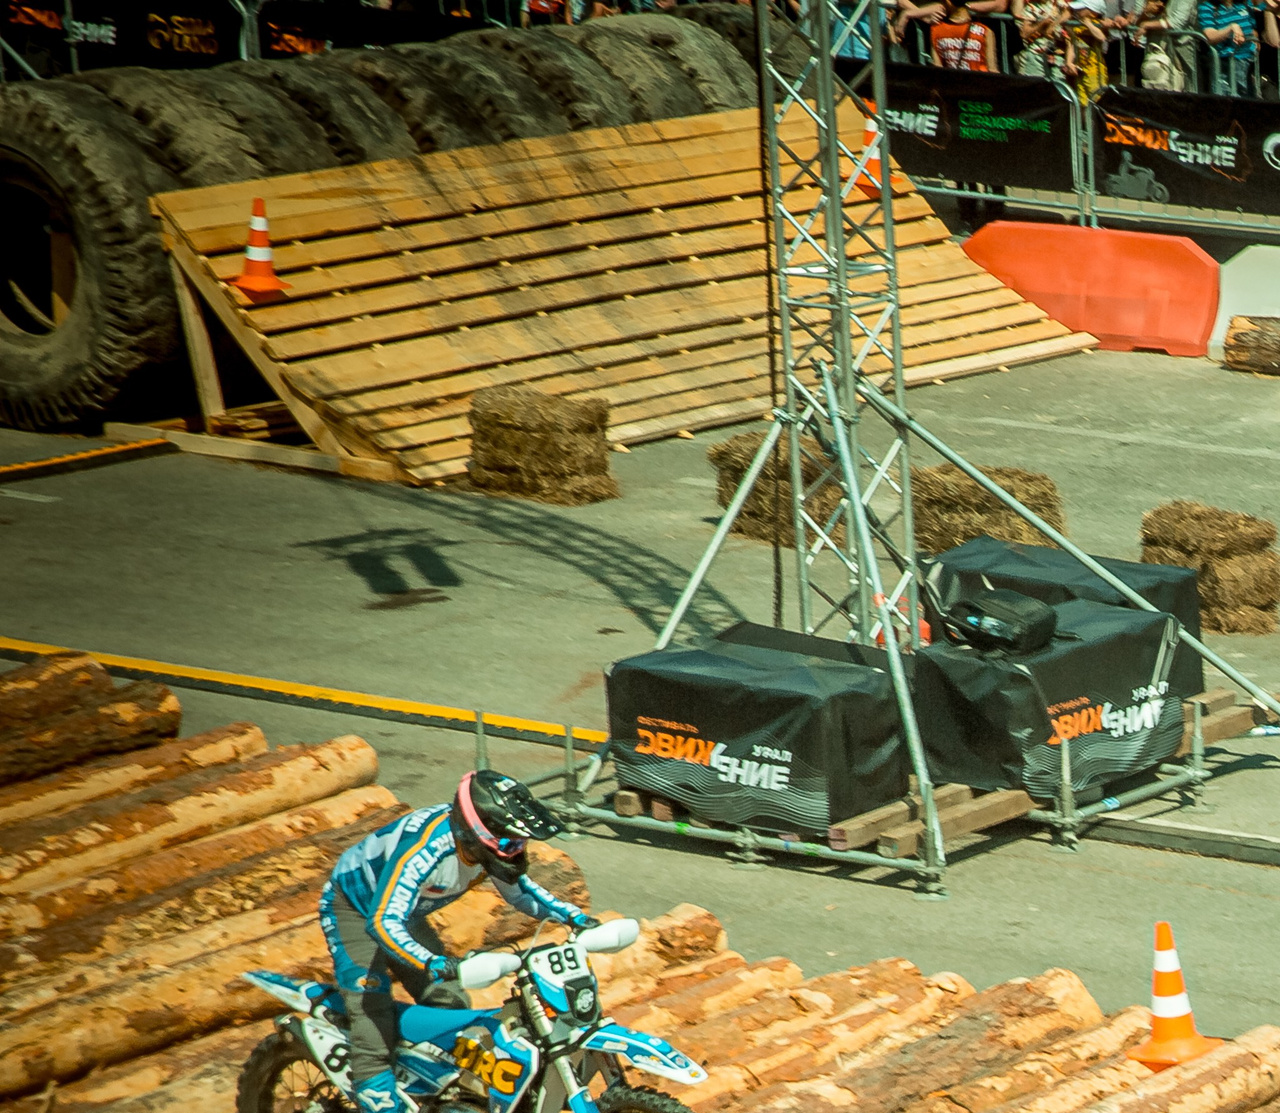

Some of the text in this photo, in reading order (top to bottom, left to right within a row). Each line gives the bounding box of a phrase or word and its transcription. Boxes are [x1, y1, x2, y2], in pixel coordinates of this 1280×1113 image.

[634, 728, 791, 792] ДВИЖЕНИЕ
[752, 744, 793, 763] УРАЛ
[399, 848, 437, 889] TEAM
[547, 947, 581, 976] 89
